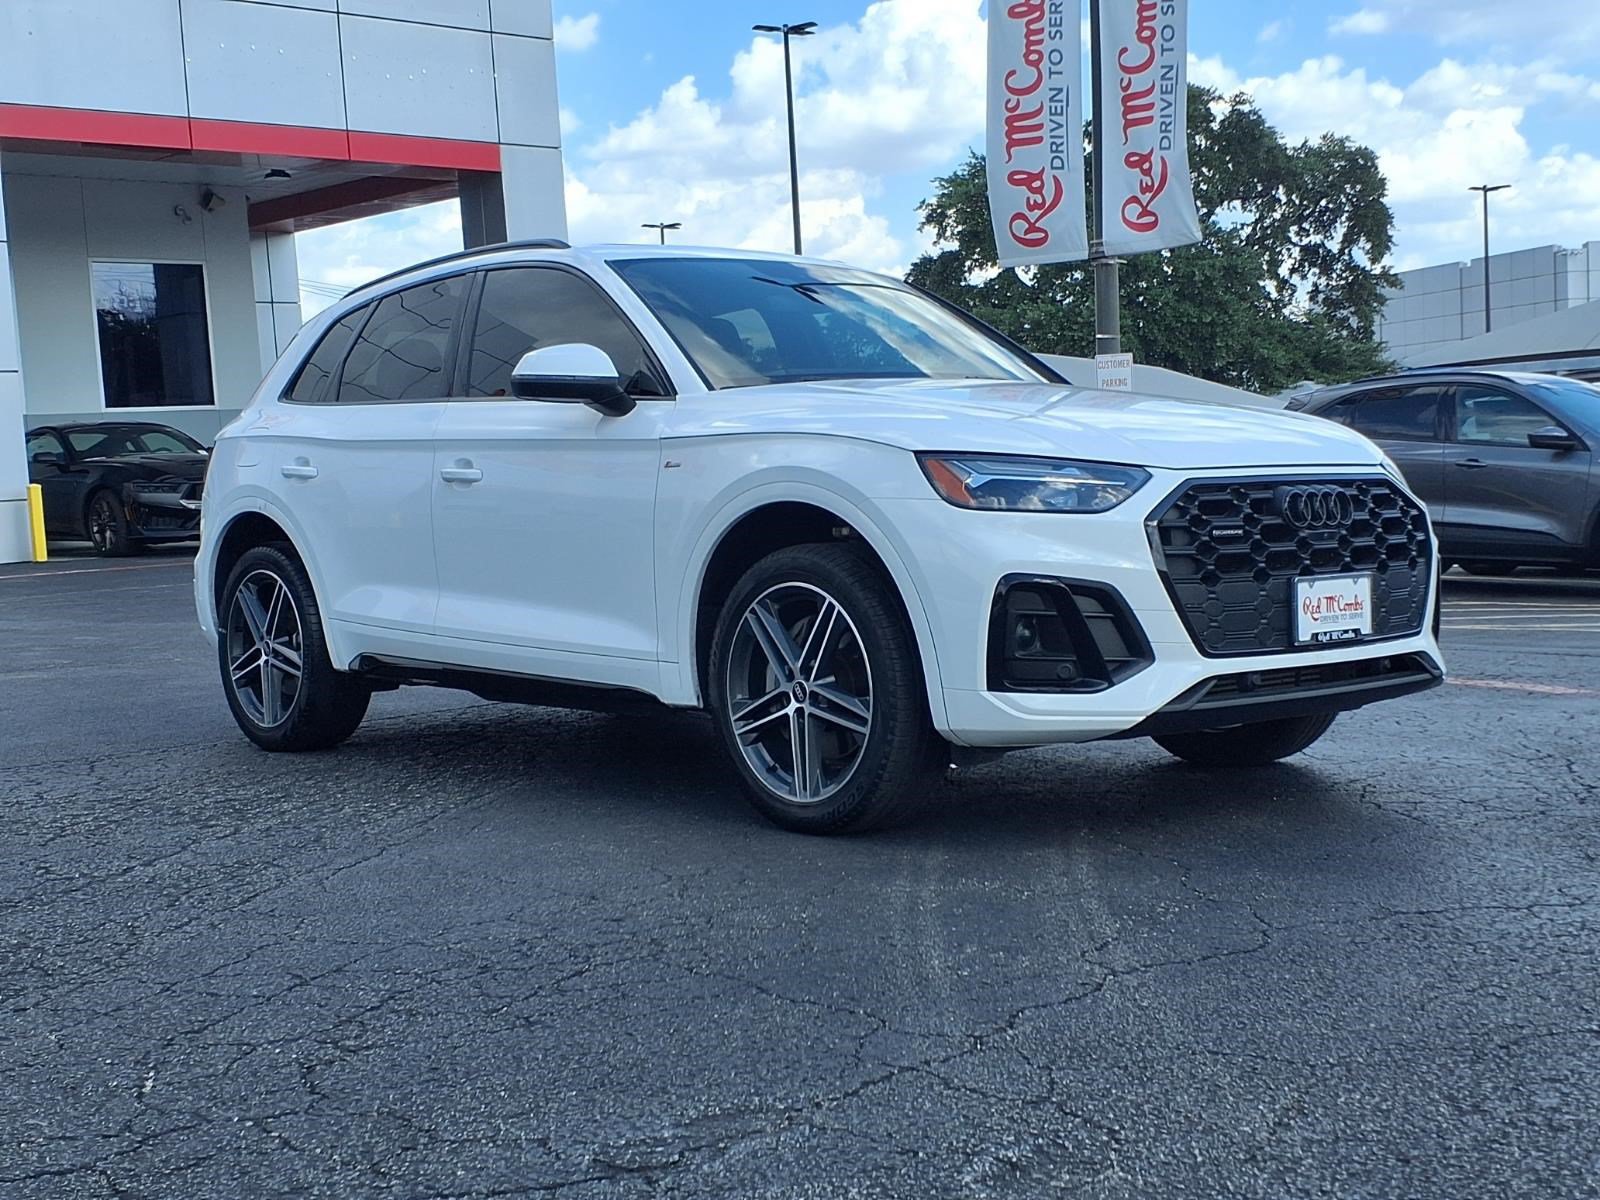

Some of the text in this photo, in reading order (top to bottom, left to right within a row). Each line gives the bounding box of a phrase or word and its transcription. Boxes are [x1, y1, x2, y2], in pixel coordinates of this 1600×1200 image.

[1048, 0, 1064, 171] DRIVEN TO SER
[1159, 0, 1175, 152] DRIVEN TO S
[1007, 167, 1064, 249] Red
[1120, 148, 1169, 233] Red
[1097, 359, 1131, 370] CUSTOMER
[1102, 377, 1128, 388] PARKING
[1303, 594, 1364, 621] Red McCombs
